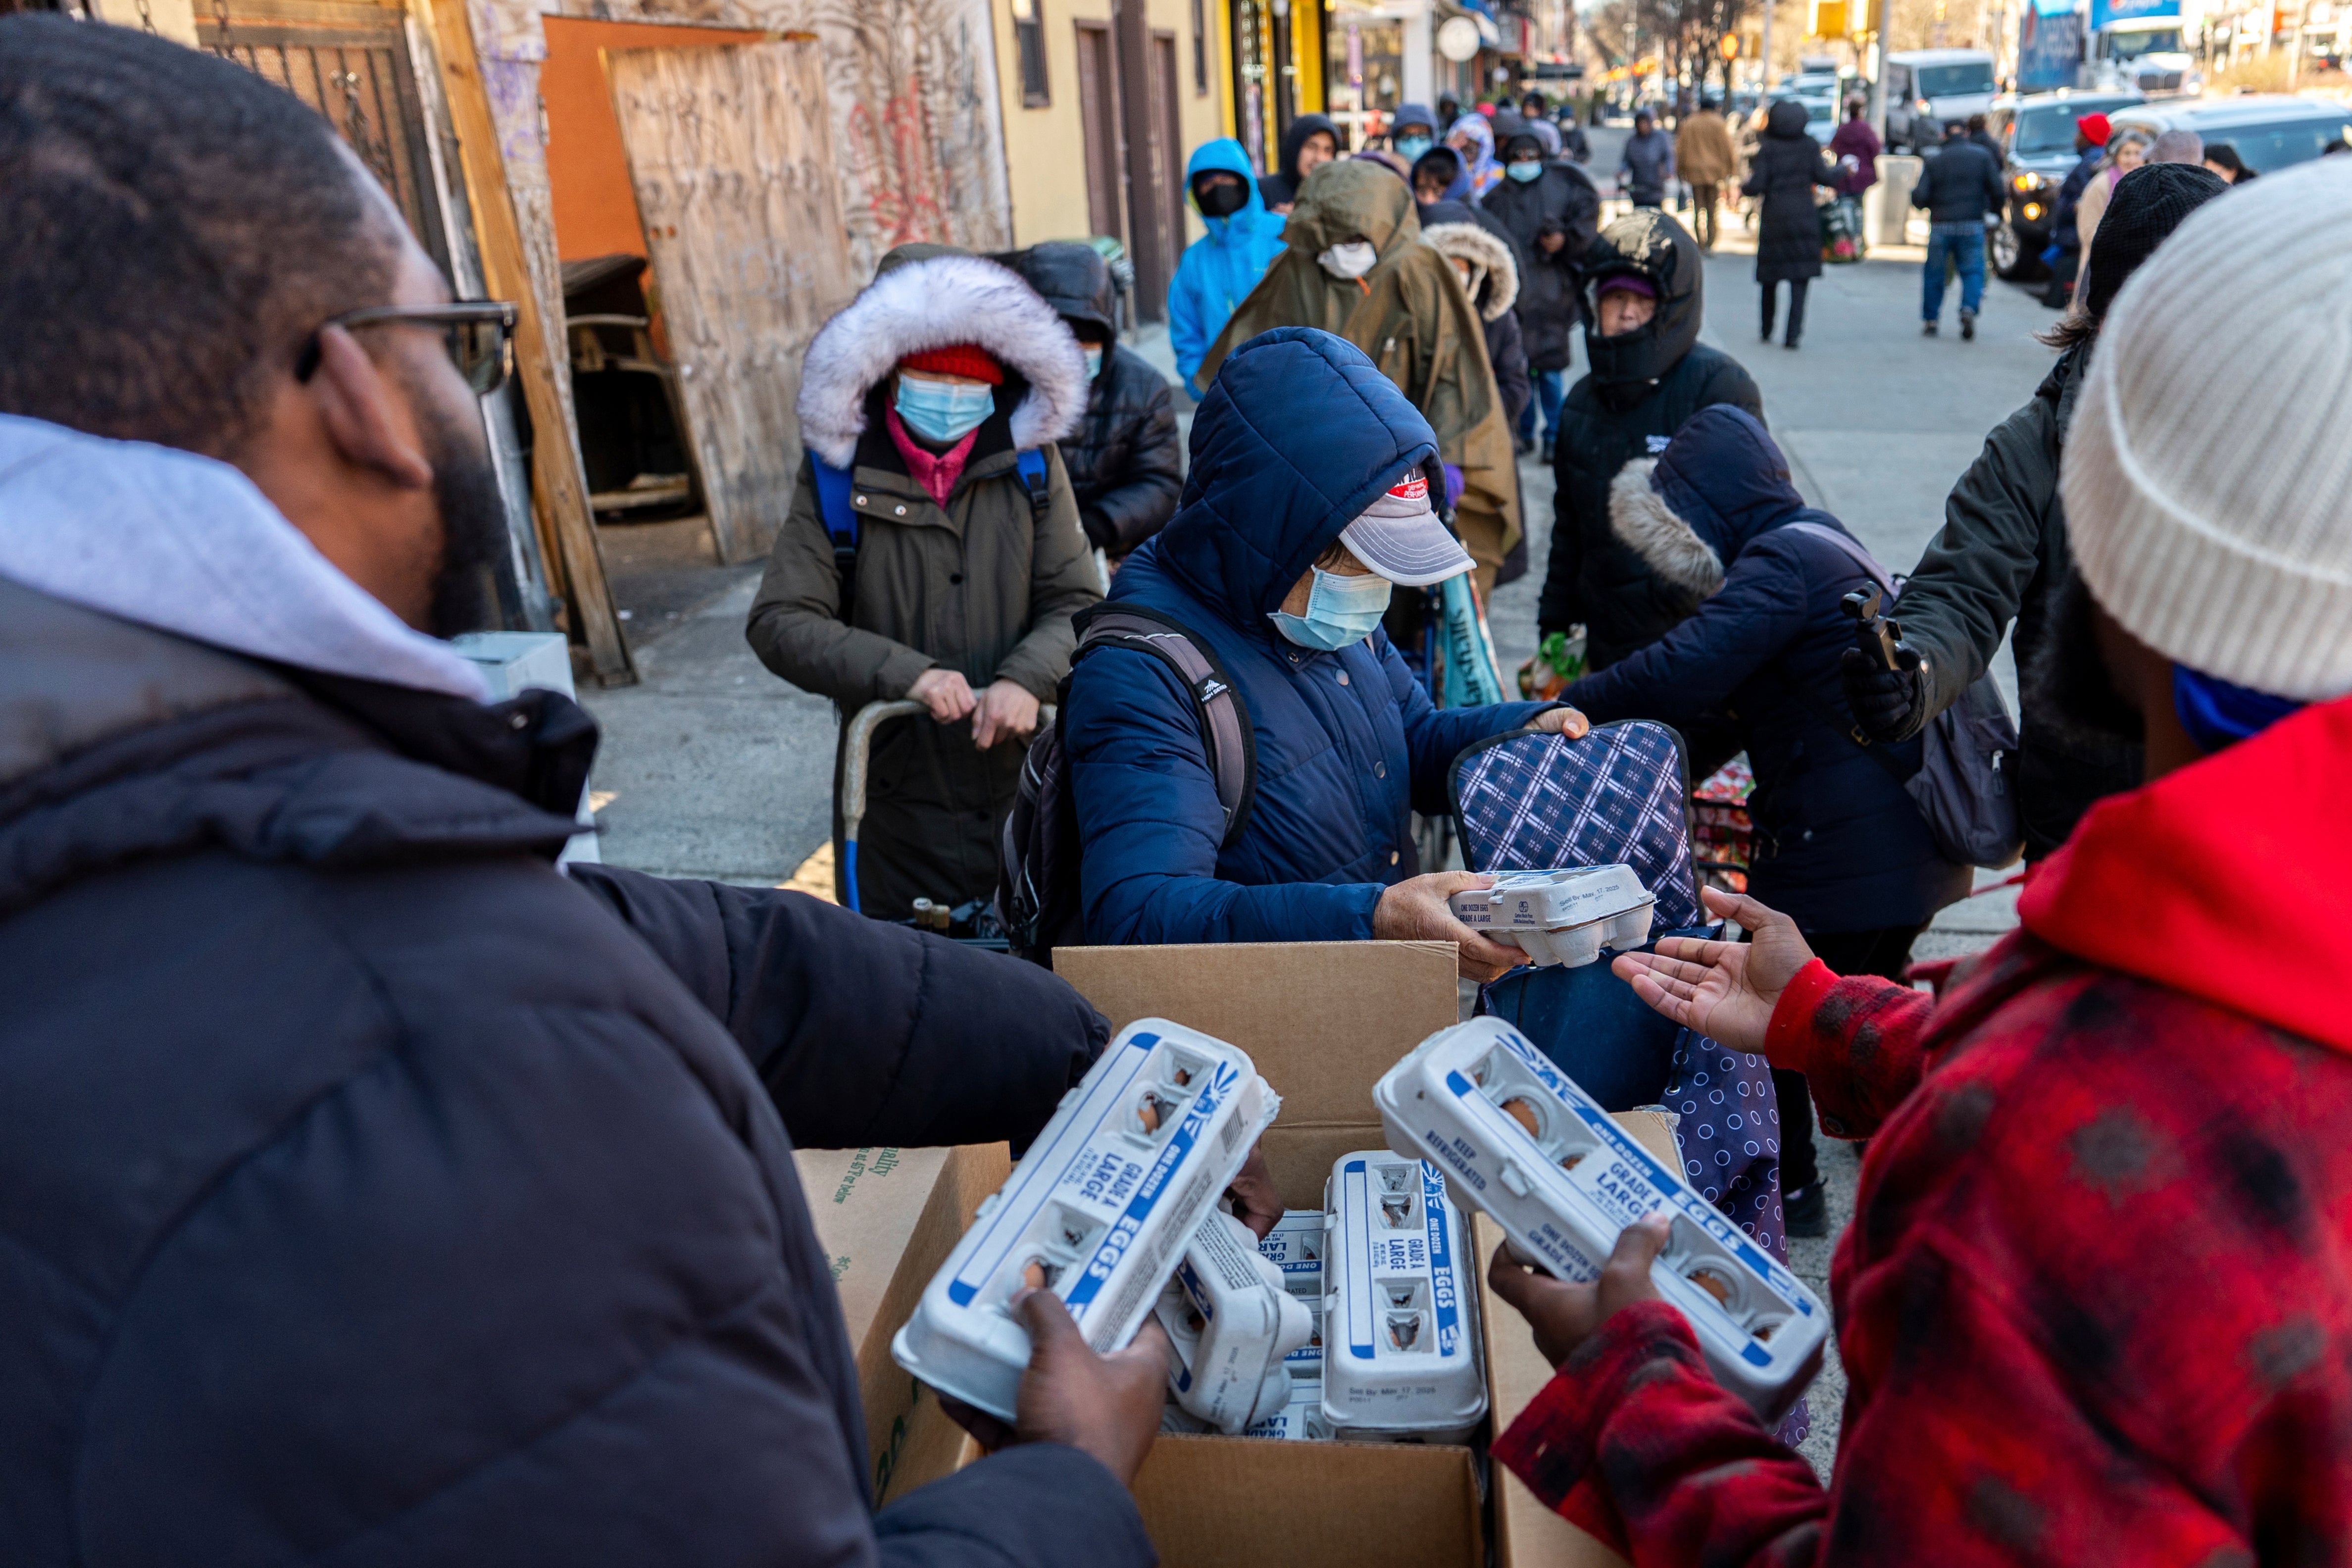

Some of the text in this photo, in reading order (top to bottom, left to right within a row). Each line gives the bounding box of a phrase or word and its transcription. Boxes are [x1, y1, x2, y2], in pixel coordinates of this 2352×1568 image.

[1559, 897, 1572, 906] Sell
[1160, 1144, 1181, 1167] ONE
[1426, 1129, 1487, 1191] REFRIGERATED
[1453, 1137, 1477, 1159] KEEP
[833, 1184, 855, 1204] below
[1080, 1152, 1124, 1201] LARGE
[1101, 1162, 1144, 1208] GRADE A
[1138, 1163, 1168, 1200] DOZEN
[1593, 1122, 1616, 1145] ONE
[1614, 1142, 1654, 1178] DOZEN
[1672, 1190, 1743, 1251] EGGS
[1611, 1162, 1653, 1200] GRADE
[1649, 1197, 1662, 1210] A
[1089, 1214, 1141, 1281] EGGS
[1258, 1242, 1287, 1251] LAR
[1262, 1253, 1285, 1261] GRA
[1389, 1239, 1406, 1270] LARGE
[1408, 1239, 1425, 1264] GRADE
[1429, 1217, 1455, 1309] ONE DOZEN EGGS
[1528, 1230, 1573, 1272] GRADE A
[1542, 1223, 1561, 1242] ONE
[1560, 1239, 1588, 1267] DOZEN
